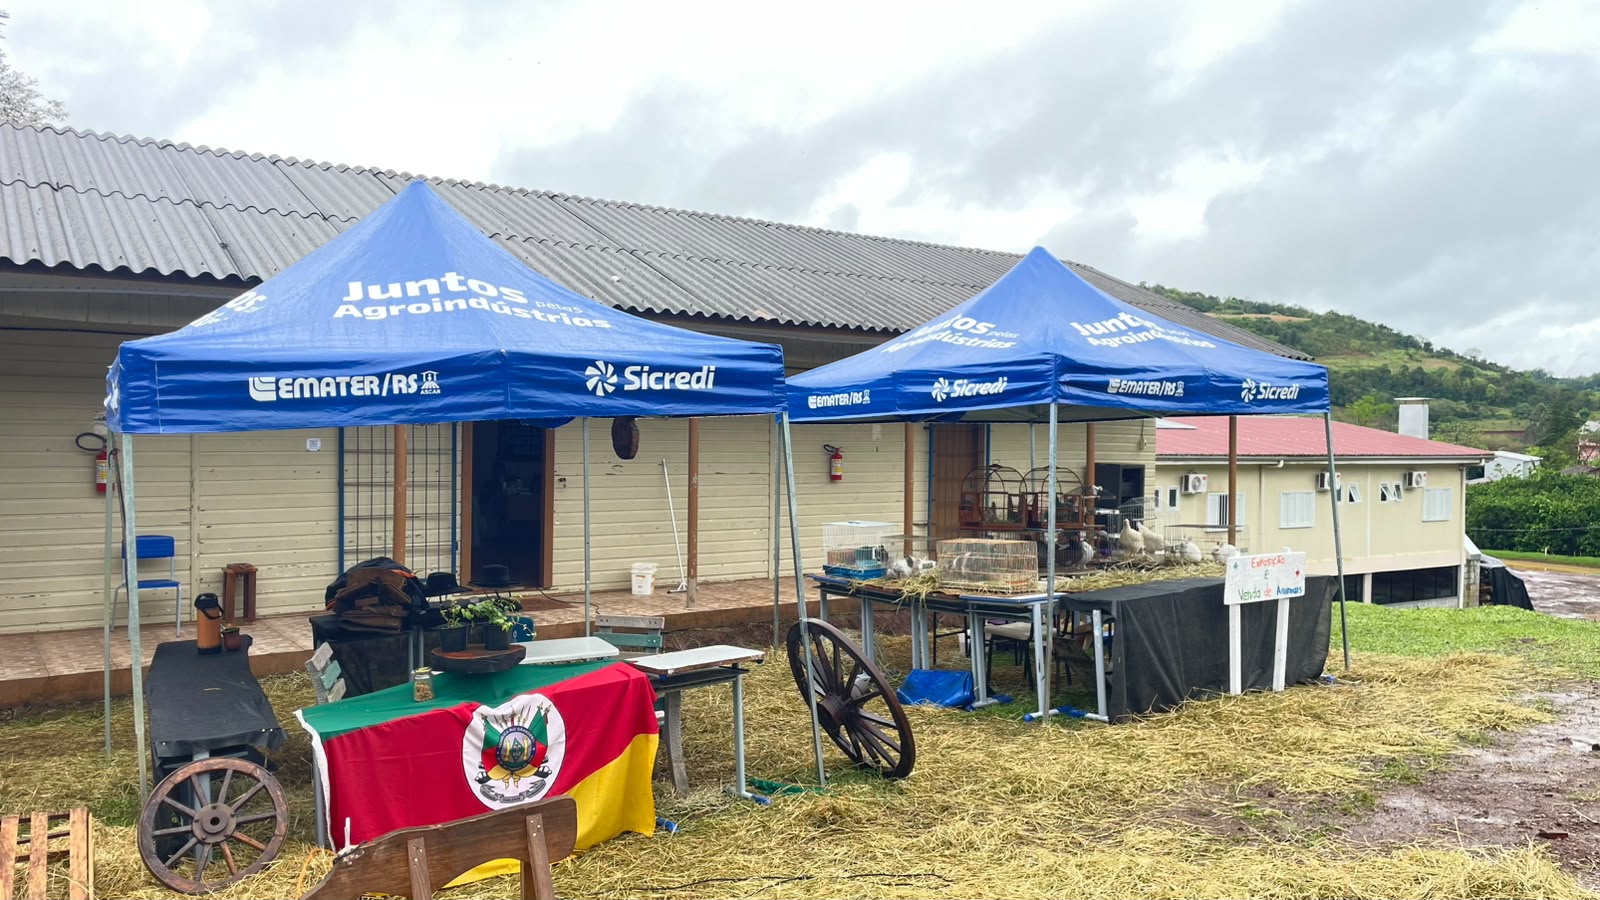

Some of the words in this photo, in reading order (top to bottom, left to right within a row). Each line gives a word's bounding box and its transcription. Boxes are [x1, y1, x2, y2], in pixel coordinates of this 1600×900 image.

[342, 271, 529, 303] Juntos
[535, 301, 584, 314] pelas
[333, 296, 613, 329] Agroindústrias
[903, 313, 996, 341] tos
[881, 330, 1017, 353] dústrias
[278, 373, 419, 399] EMATER/RS
[623, 365, 717, 392] Sicredi
[950, 376, 1008, 398] Sicredi
[1118, 380, 1177, 397] EMATER/RS
[816, 391, 863, 408] EMATER/RS
[1256, 382, 1300, 400] Sicredi
[1238, 585, 1261, 601] Venda
